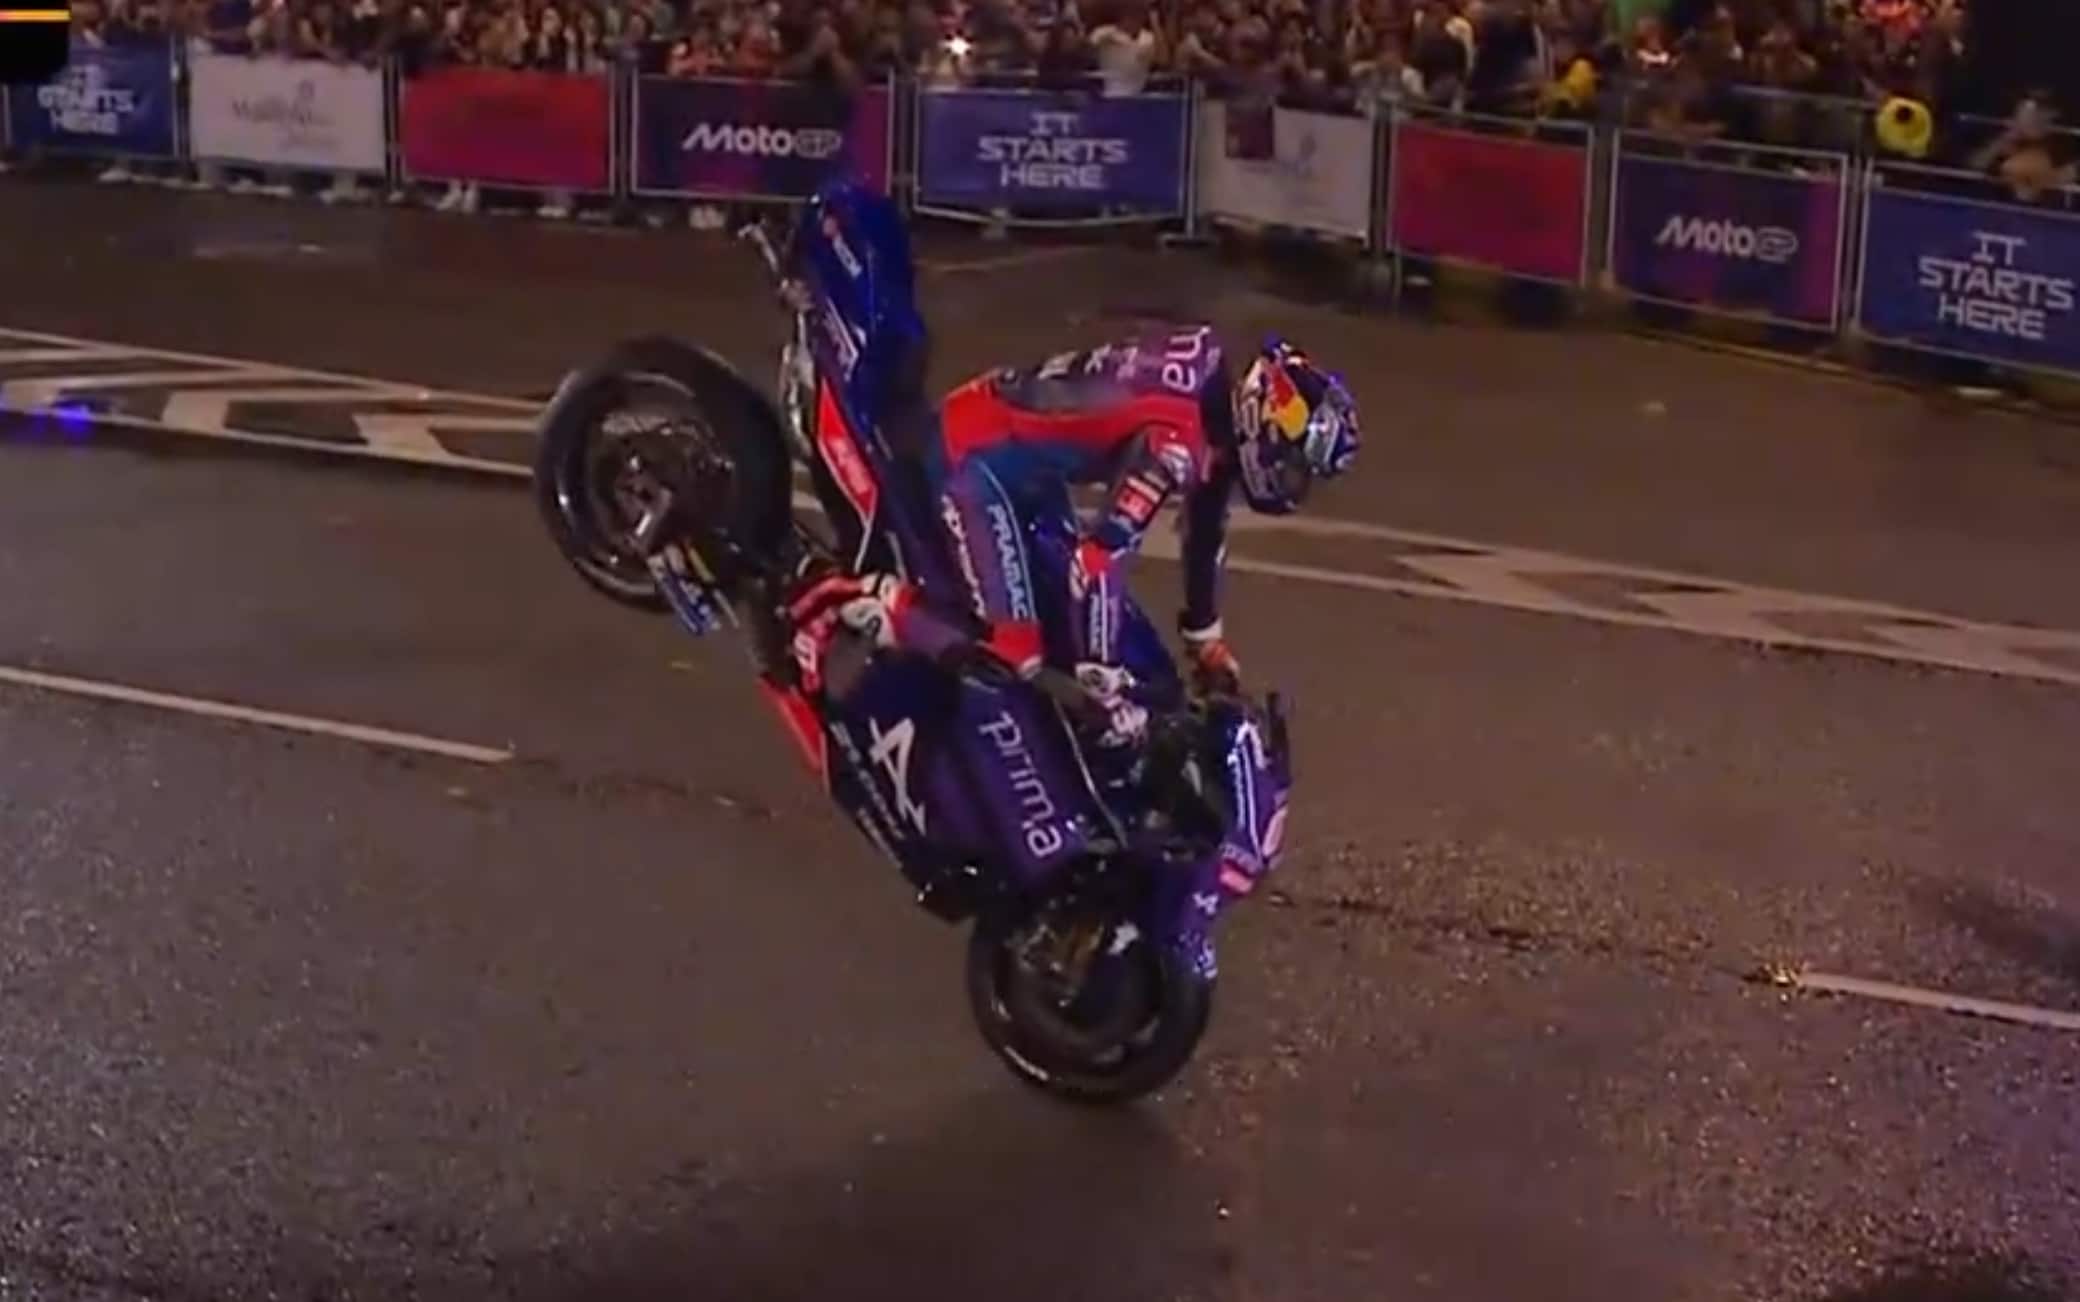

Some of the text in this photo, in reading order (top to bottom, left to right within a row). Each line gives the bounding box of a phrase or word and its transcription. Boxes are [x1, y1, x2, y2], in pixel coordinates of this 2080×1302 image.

[1029, 112, 1077, 135] IT
[683, 123, 842, 159] MotoGP
[978, 135, 1128, 163] STARTS
[1001, 163, 1104, 188] HERE
[1972, 231, 2026, 264] IT
[1918, 256, 2075, 310] STARTS
[1938, 296, 2047, 340] HERE
[978, 710, 1064, 857] prima
